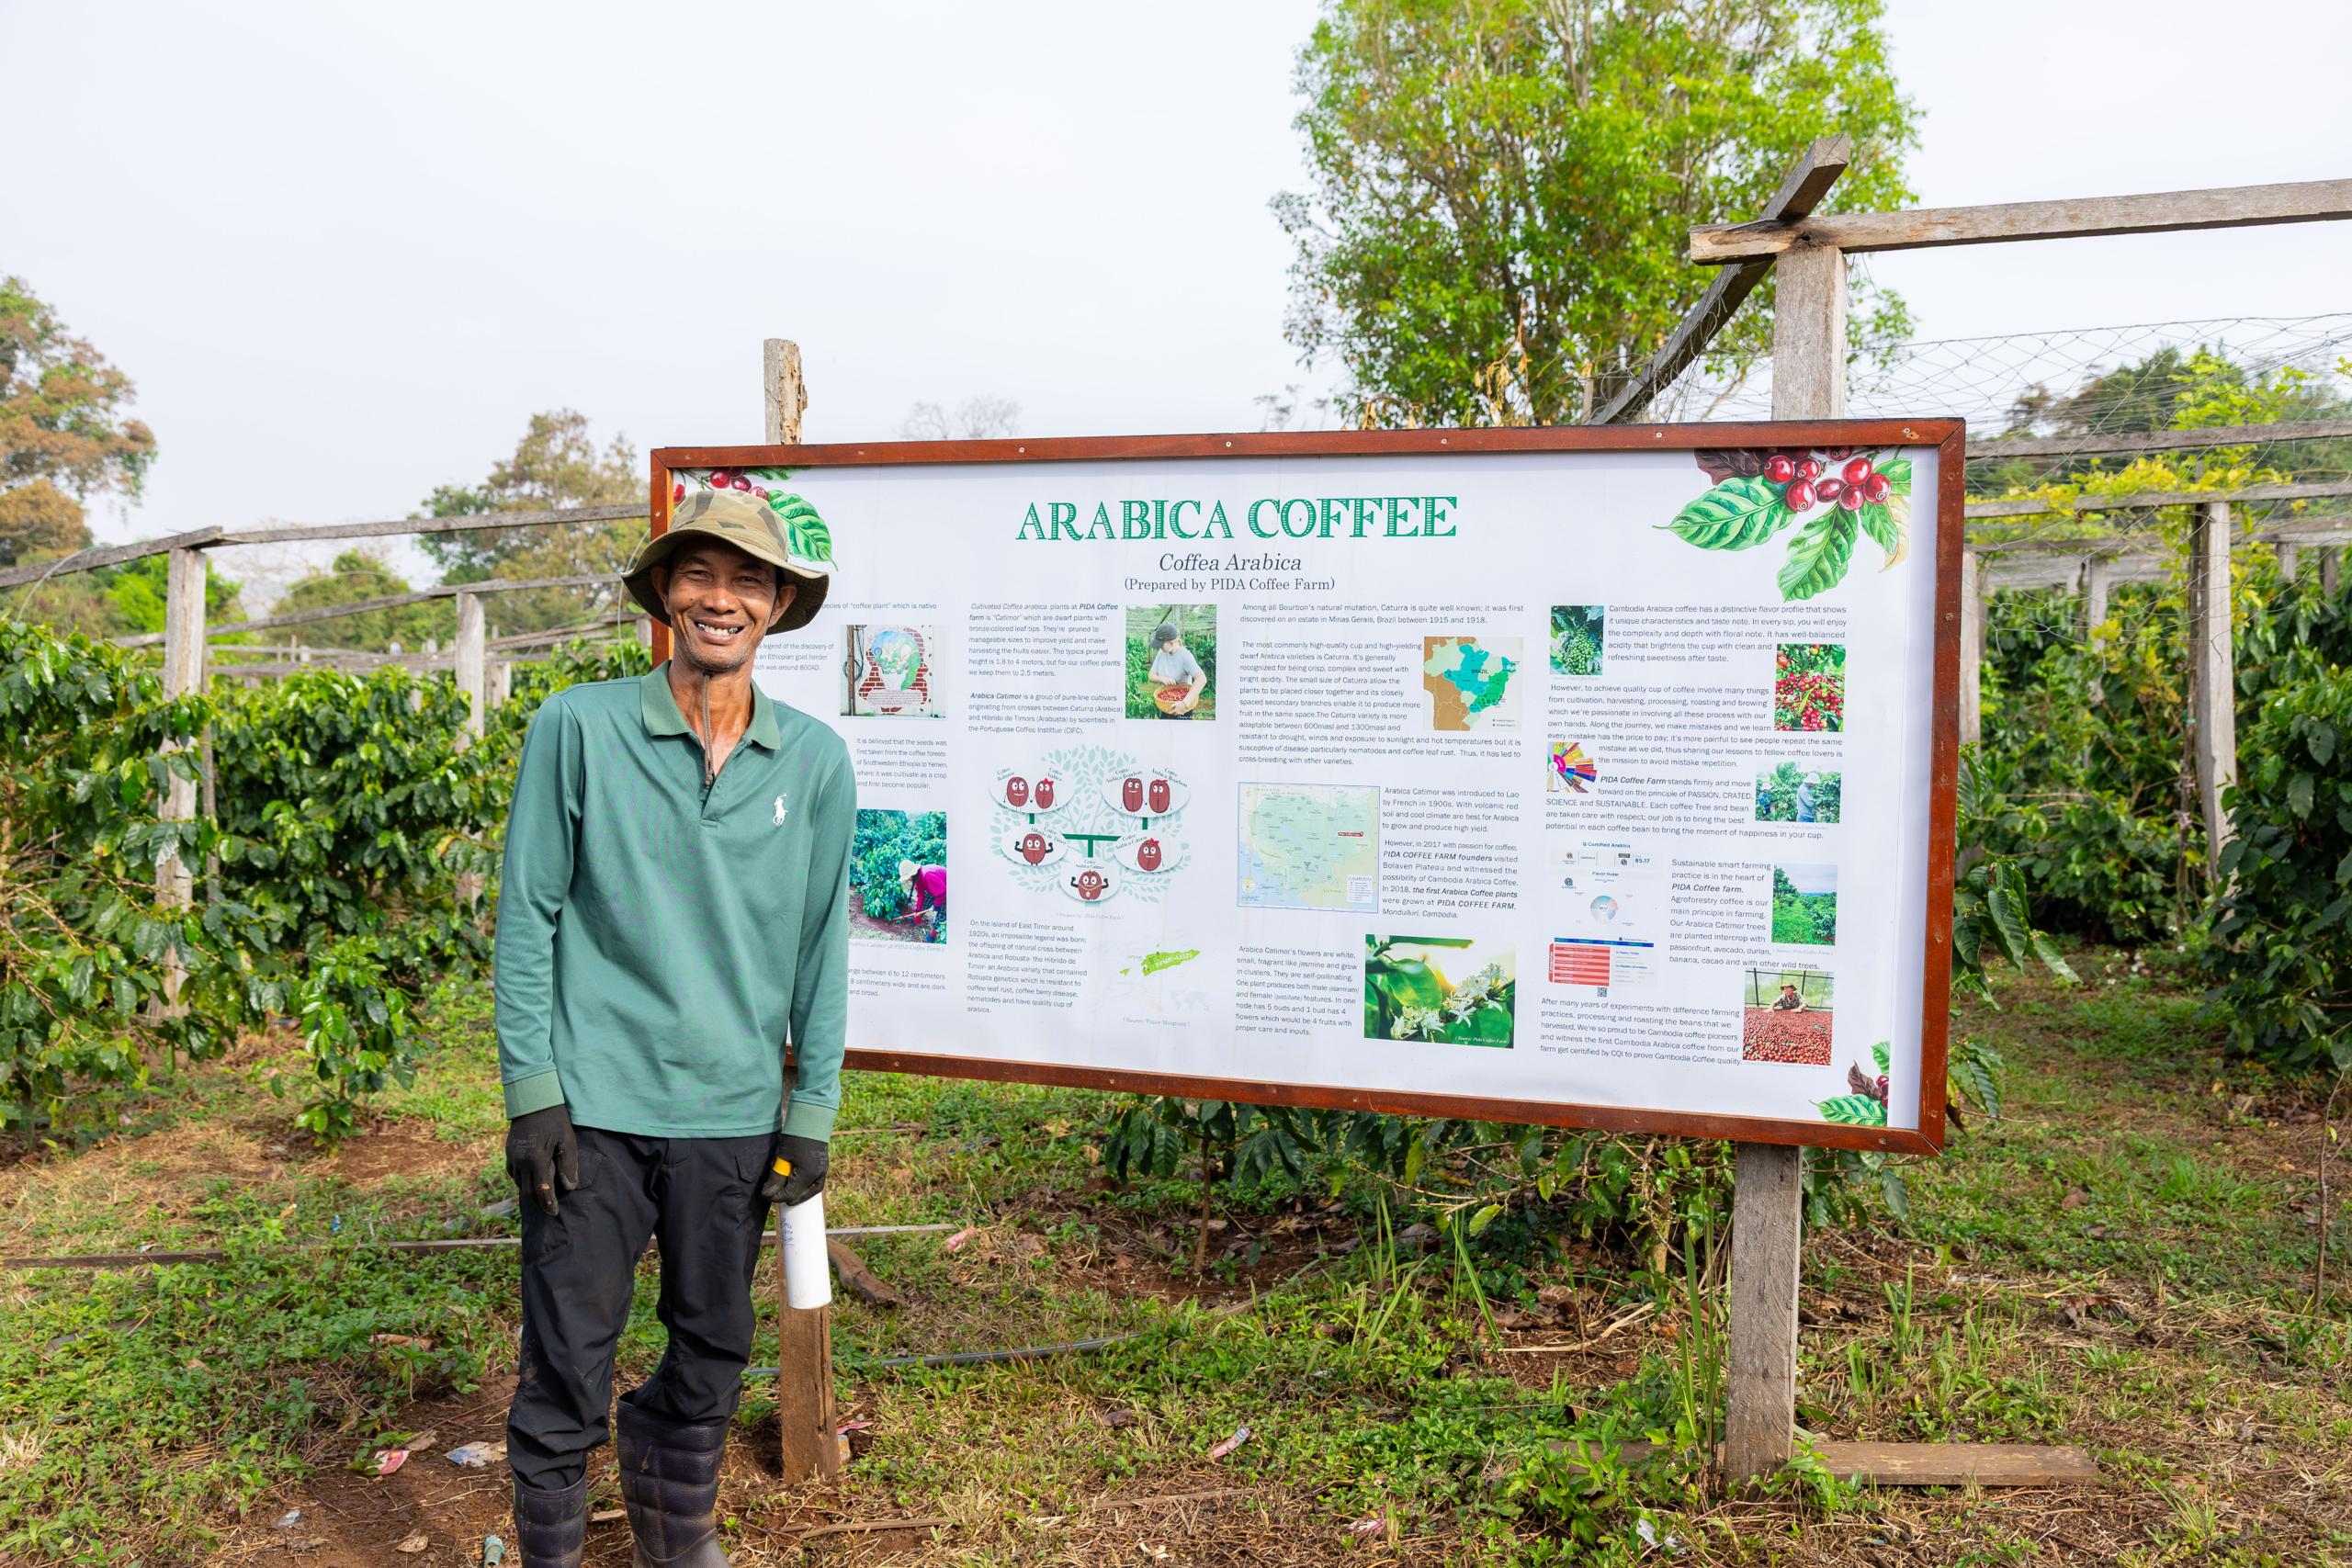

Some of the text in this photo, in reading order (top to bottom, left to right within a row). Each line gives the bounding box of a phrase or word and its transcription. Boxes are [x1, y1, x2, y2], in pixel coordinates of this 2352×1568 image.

[1015, 497, 1458, 541] ARABICA COFFEE
[1159, 553, 1301, 571] Coffea Arabica
[1125, 576, 1335, 592] (Prepared by PIDA Coffee Farm)
[1600, 775, 1619, 784] PIDA
[1620, 776, 1645, 784] Coffee
[1693, 779, 1713, 787] firmly
[1402, 851, 1432, 859] COFFEE
[1671, 859, 1716, 868] Sustainable
[1741, 863, 1771, 871] farming
[1671, 883, 1691, 891] PIDA
[1693, 884, 1721, 892] Coffee
[1238, 945, 1263, 953] Arabica
[1264, 947, 1296, 955] Catimor's
[1541, 998, 1558, 1006] After
[1600, 1001, 1609, 1010] of
[1610, 1003, 1655, 1012] experiments
[1672, 1007, 1710, 1015] difference
[1711, 1009, 1740, 1018] farming
